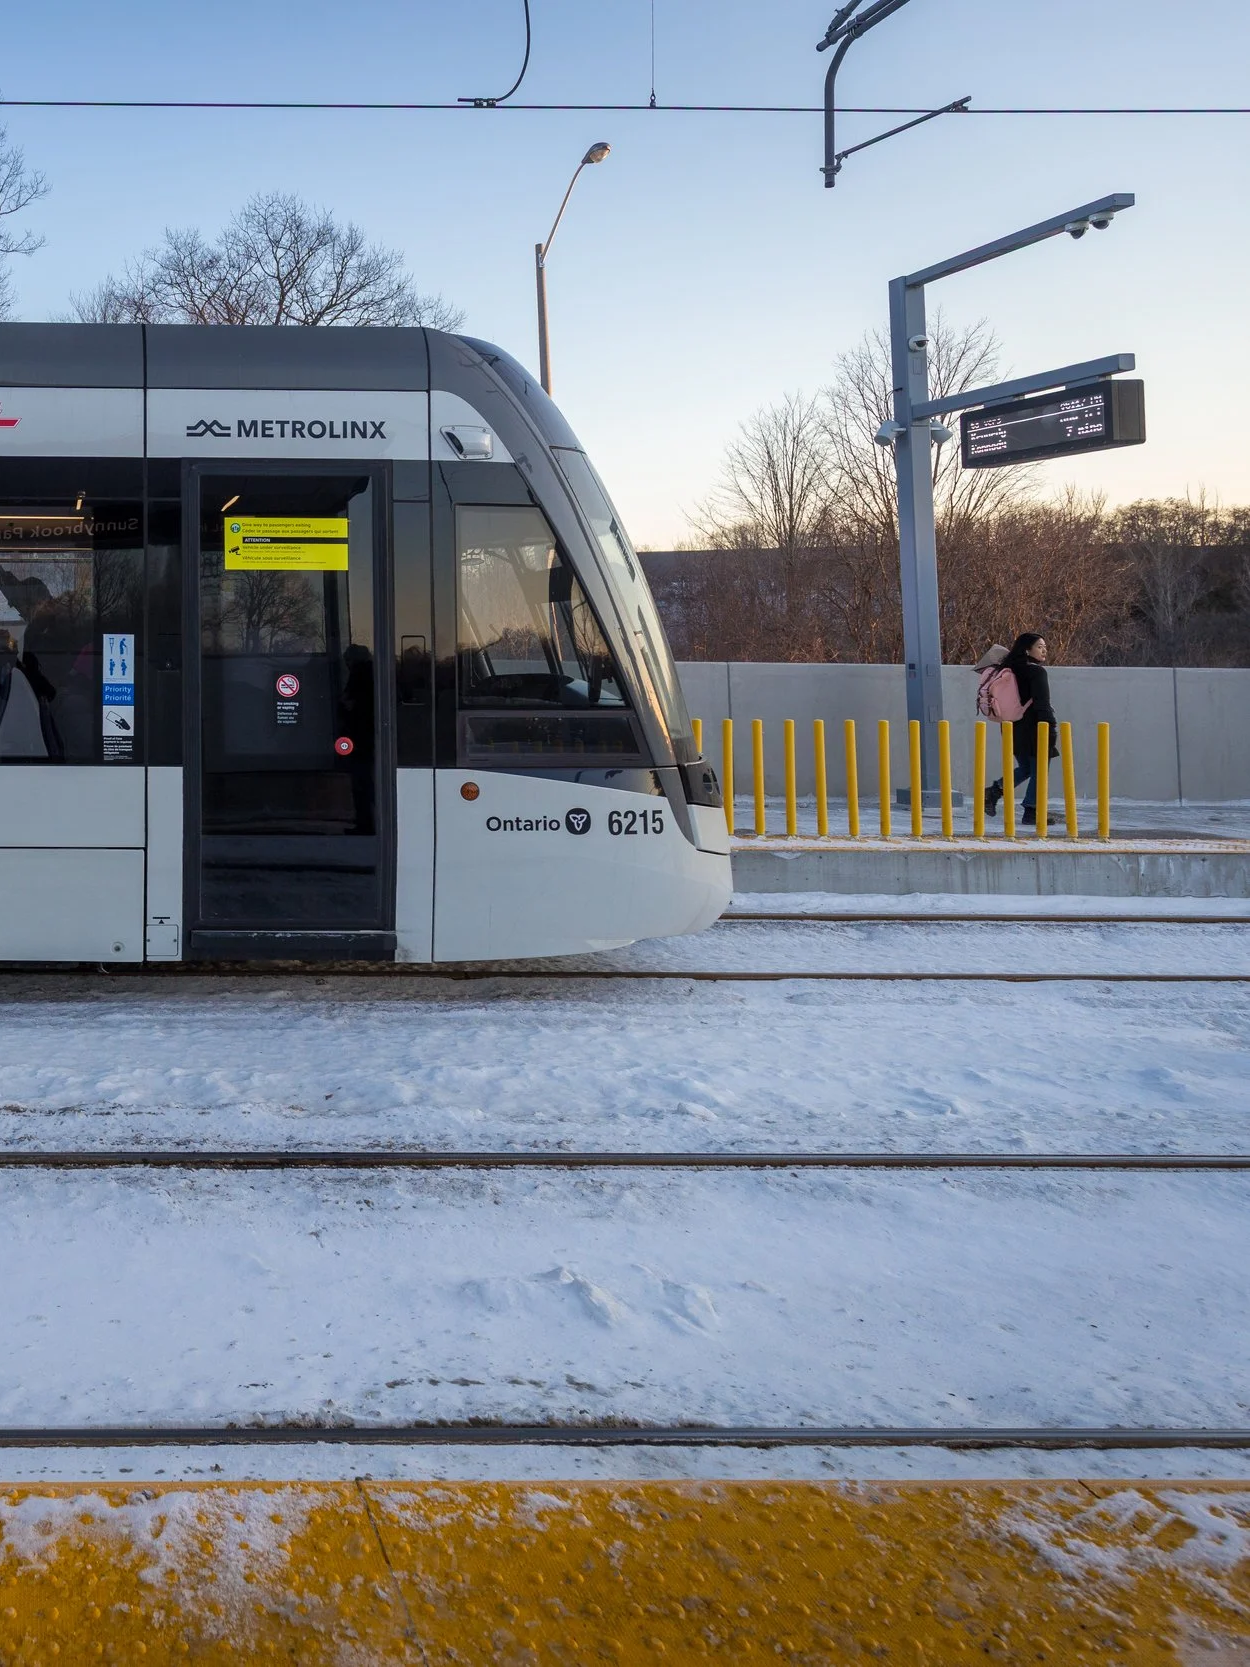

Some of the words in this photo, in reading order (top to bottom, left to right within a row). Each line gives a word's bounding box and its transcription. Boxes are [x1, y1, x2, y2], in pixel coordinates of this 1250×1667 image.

[237, 419, 387, 439] METROLINX
[105, 685, 132, 694] Priority
[485, 816, 561, 832] Ontario
[607, 809, 665, 836] 6215
